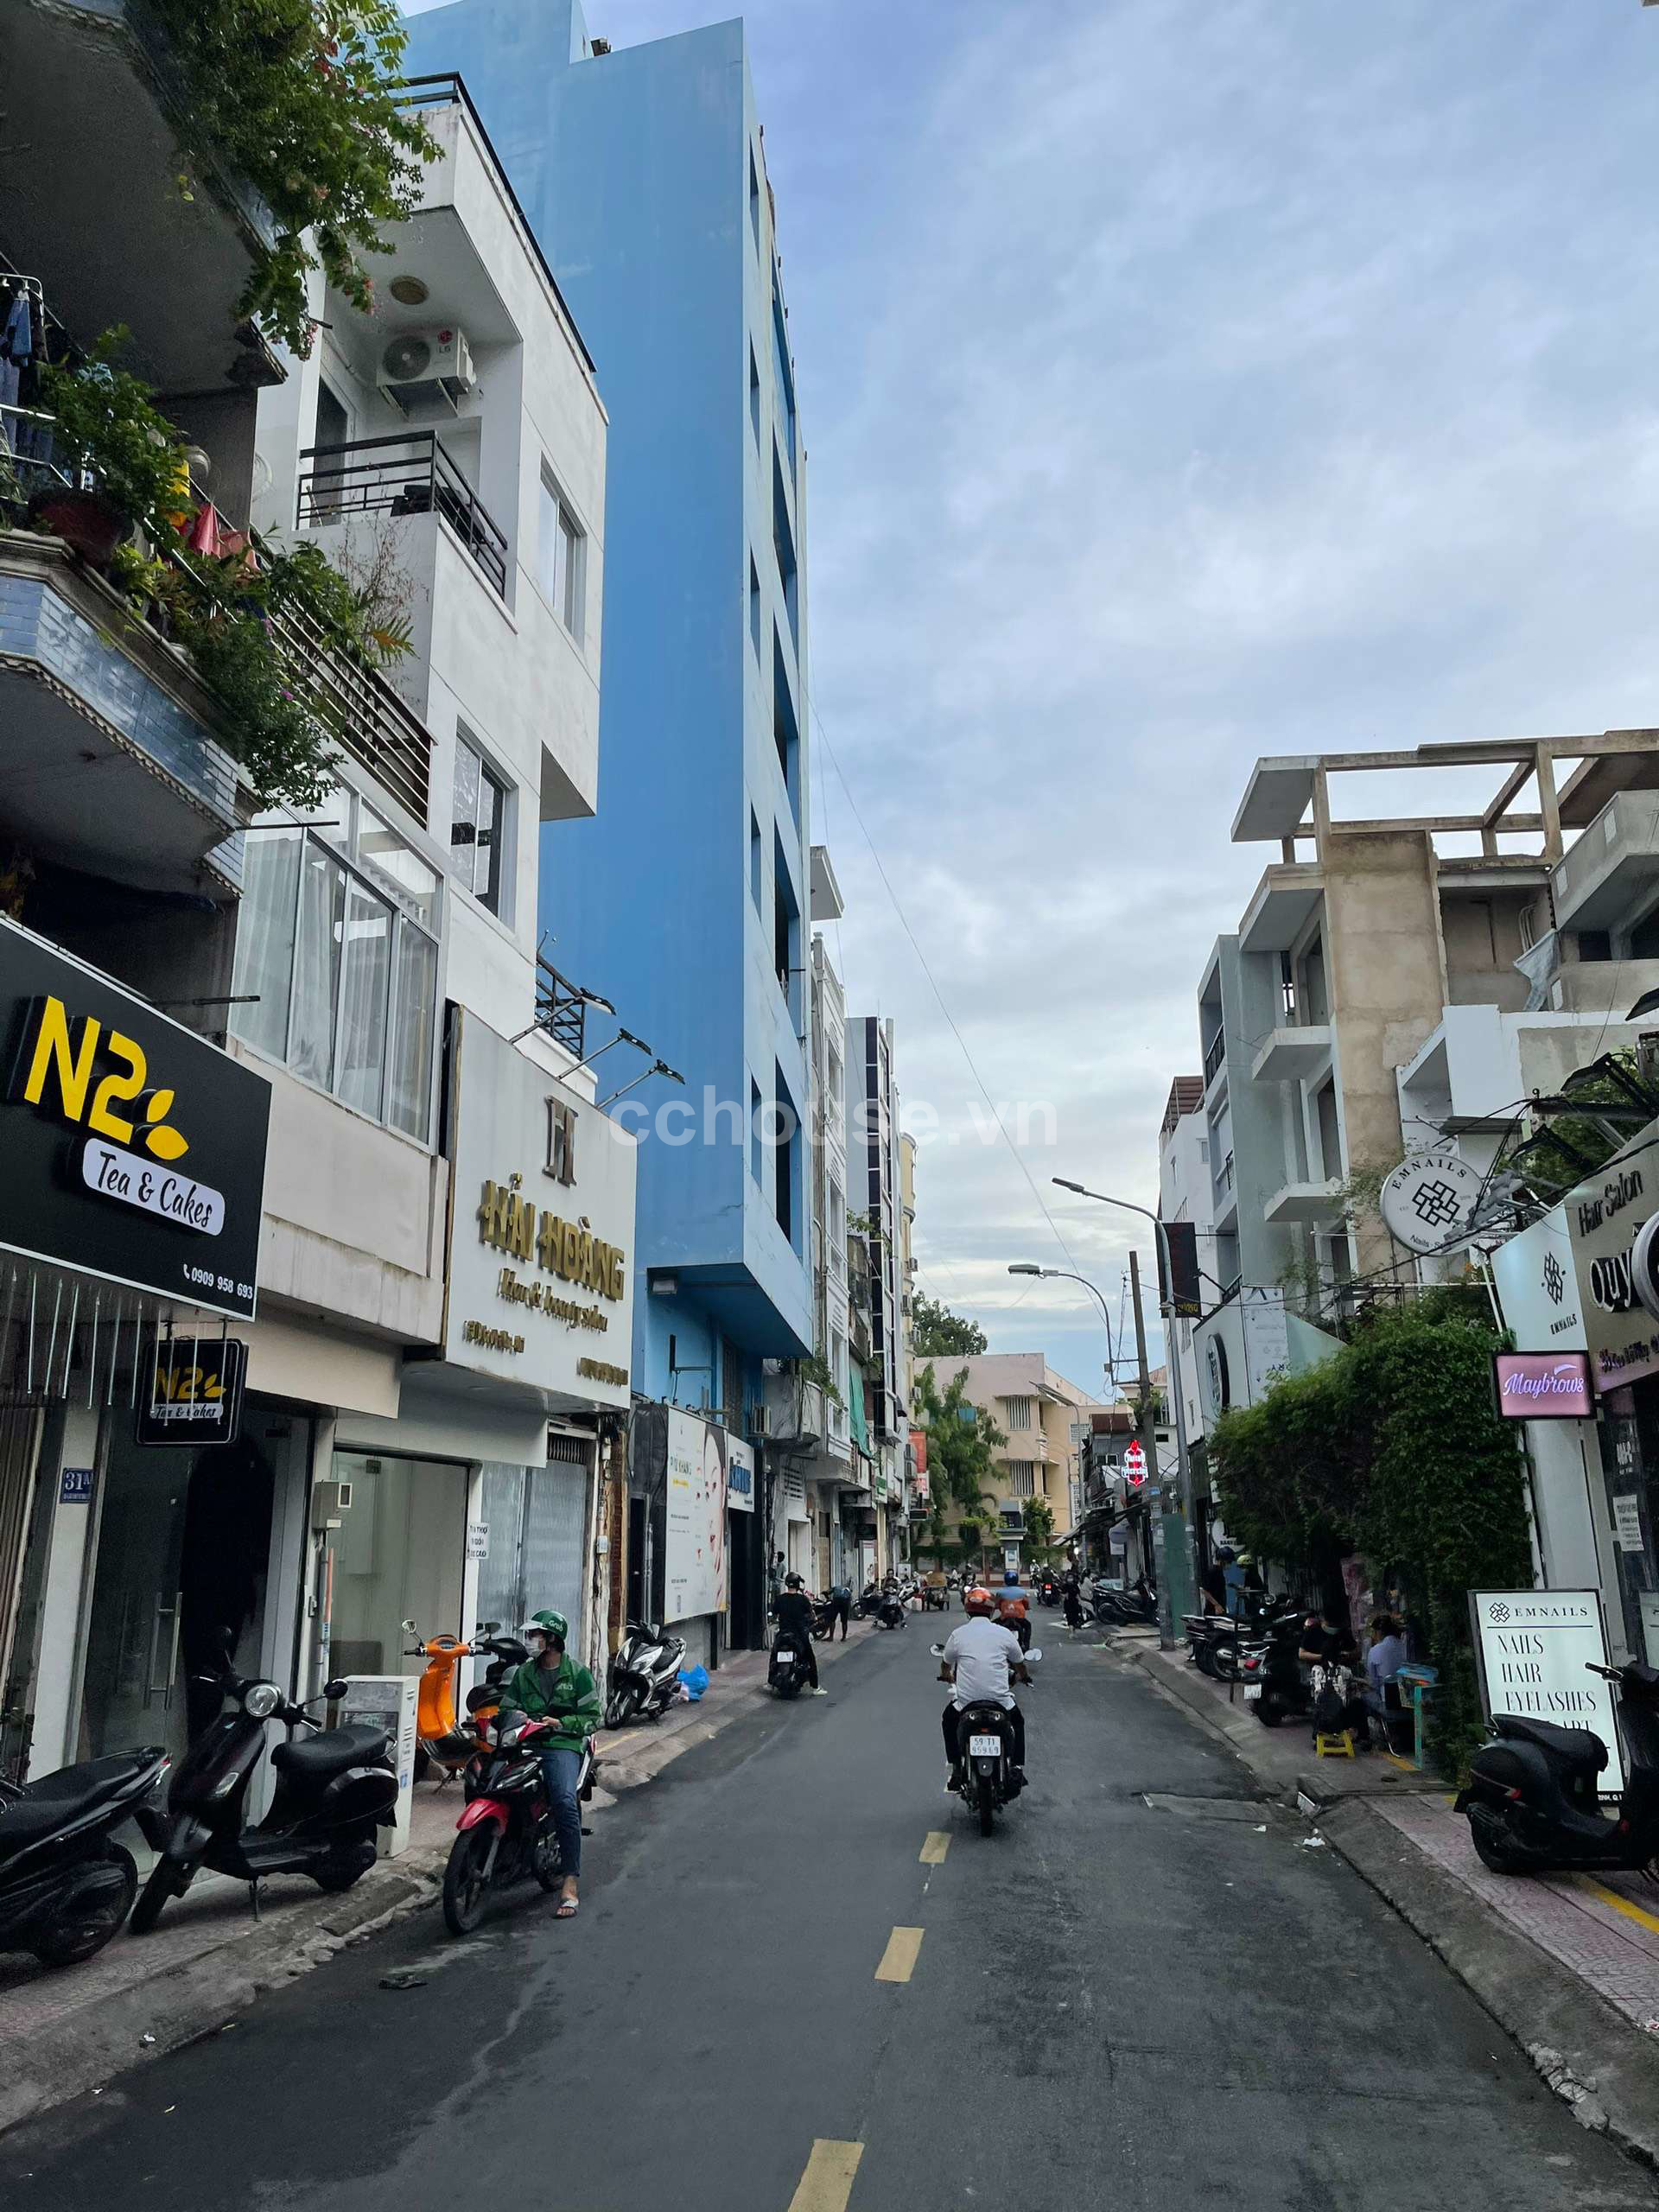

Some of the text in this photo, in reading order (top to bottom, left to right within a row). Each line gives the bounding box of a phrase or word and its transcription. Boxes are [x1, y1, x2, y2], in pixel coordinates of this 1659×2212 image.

[24, 995, 147, 1144] N2
[1392, 1158, 1467, 1191] EMNAILS
[96, 1150, 213, 1228] Tea & Cakes
[1604, 1168, 1643, 1217] Salon
[191, 1267, 253, 1300] 0909 958 693
[1503, 1372, 1585, 1400] Maybrows
[549, 1620, 564, 1632] Grab
[1515, 1607, 1588, 1618] EMNAILS
[1497, 1633, 1544, 1655] NAILS
[1502, 1662, 1542, 1683] HAIR
[1505, 1691, 1597, 1712] EYELASHES
